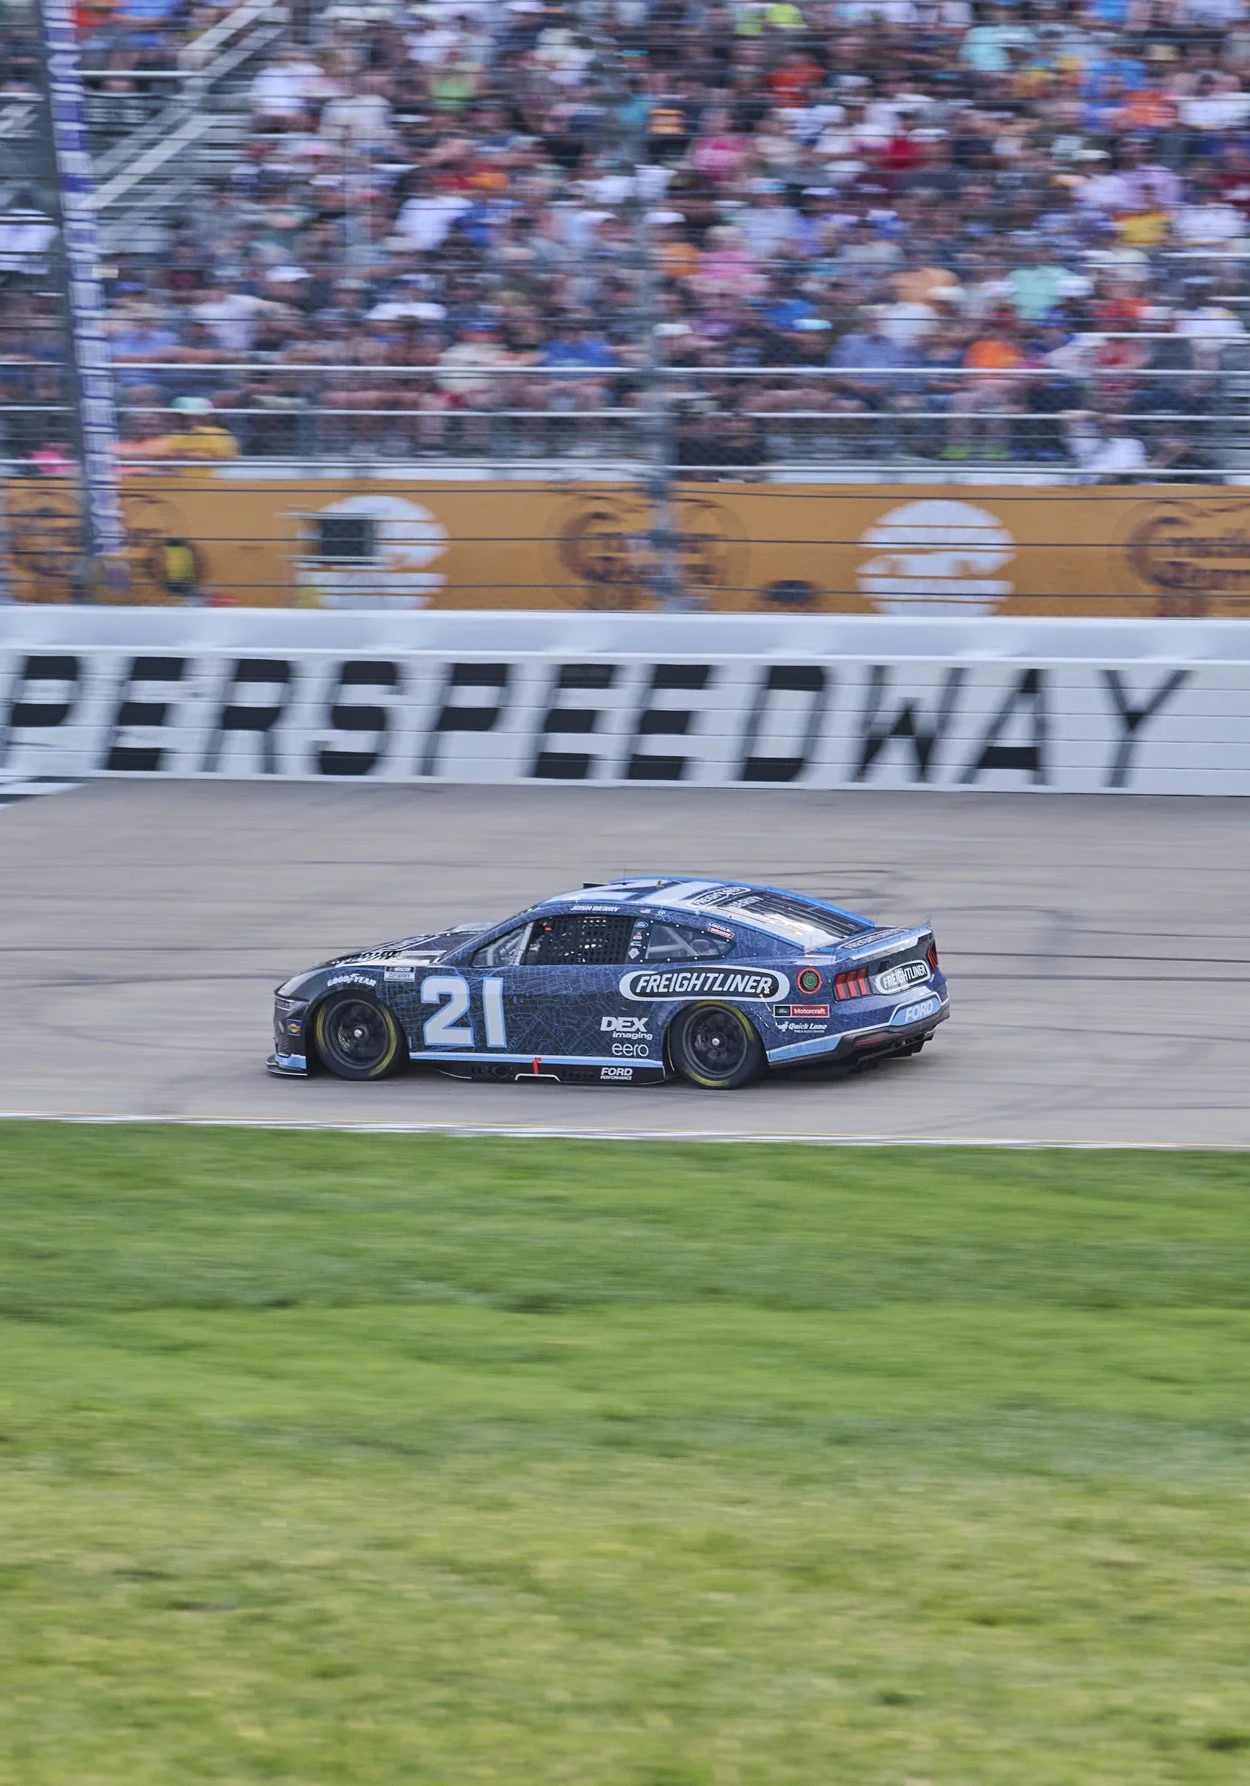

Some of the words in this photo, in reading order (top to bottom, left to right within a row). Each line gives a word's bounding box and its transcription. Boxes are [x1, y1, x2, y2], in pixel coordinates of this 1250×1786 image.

[327, 973, 377, 987] GOODYEAR
[636, 973, 773, 995] FREIGHTLINER
[882, 964, 927, 989] FREIGHTLINER
[421, 975, 507, 1047] 21
[904, 1000, 934, 1022] FORD
[600, 1016, 649, 1032] DEX
[788, 1022, 809, 1030] Quick
[612, 1031, 653, 1040] imaging
[612, 1043, 649, 1057] eero
[601, 1067, 633, 1076] FORD
